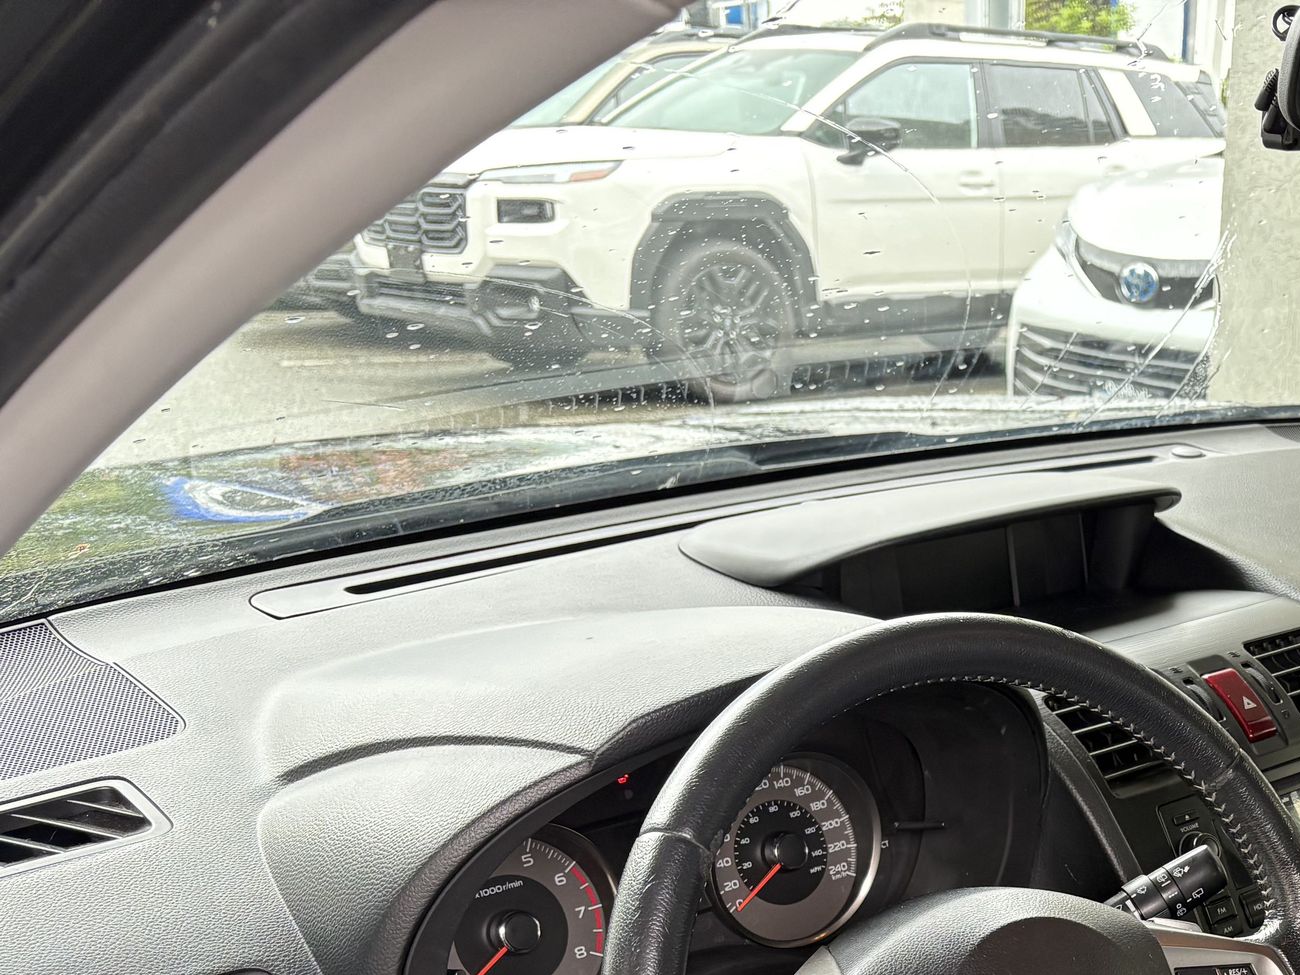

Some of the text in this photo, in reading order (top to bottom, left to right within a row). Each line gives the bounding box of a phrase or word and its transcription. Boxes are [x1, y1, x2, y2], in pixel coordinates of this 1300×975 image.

[773, 777, 791, 789] 140
[794, 785, 811, 797] 160
[810, 799, 827, 811] 180
[822, 819, 840, 830] 200
[828, 840, 846, 852] 220
[521, 854, 534, 867] 5
[717, 858, 732, 867] 40
[829, 863, 848, 875] 240
[555, 873, 566, 886] 6
[724, 880, 739, 890] 20
[575, 906, 585, 918] 7
[1223, 926, 1233, 934] AM
[574, 946, 587, 959] 8
